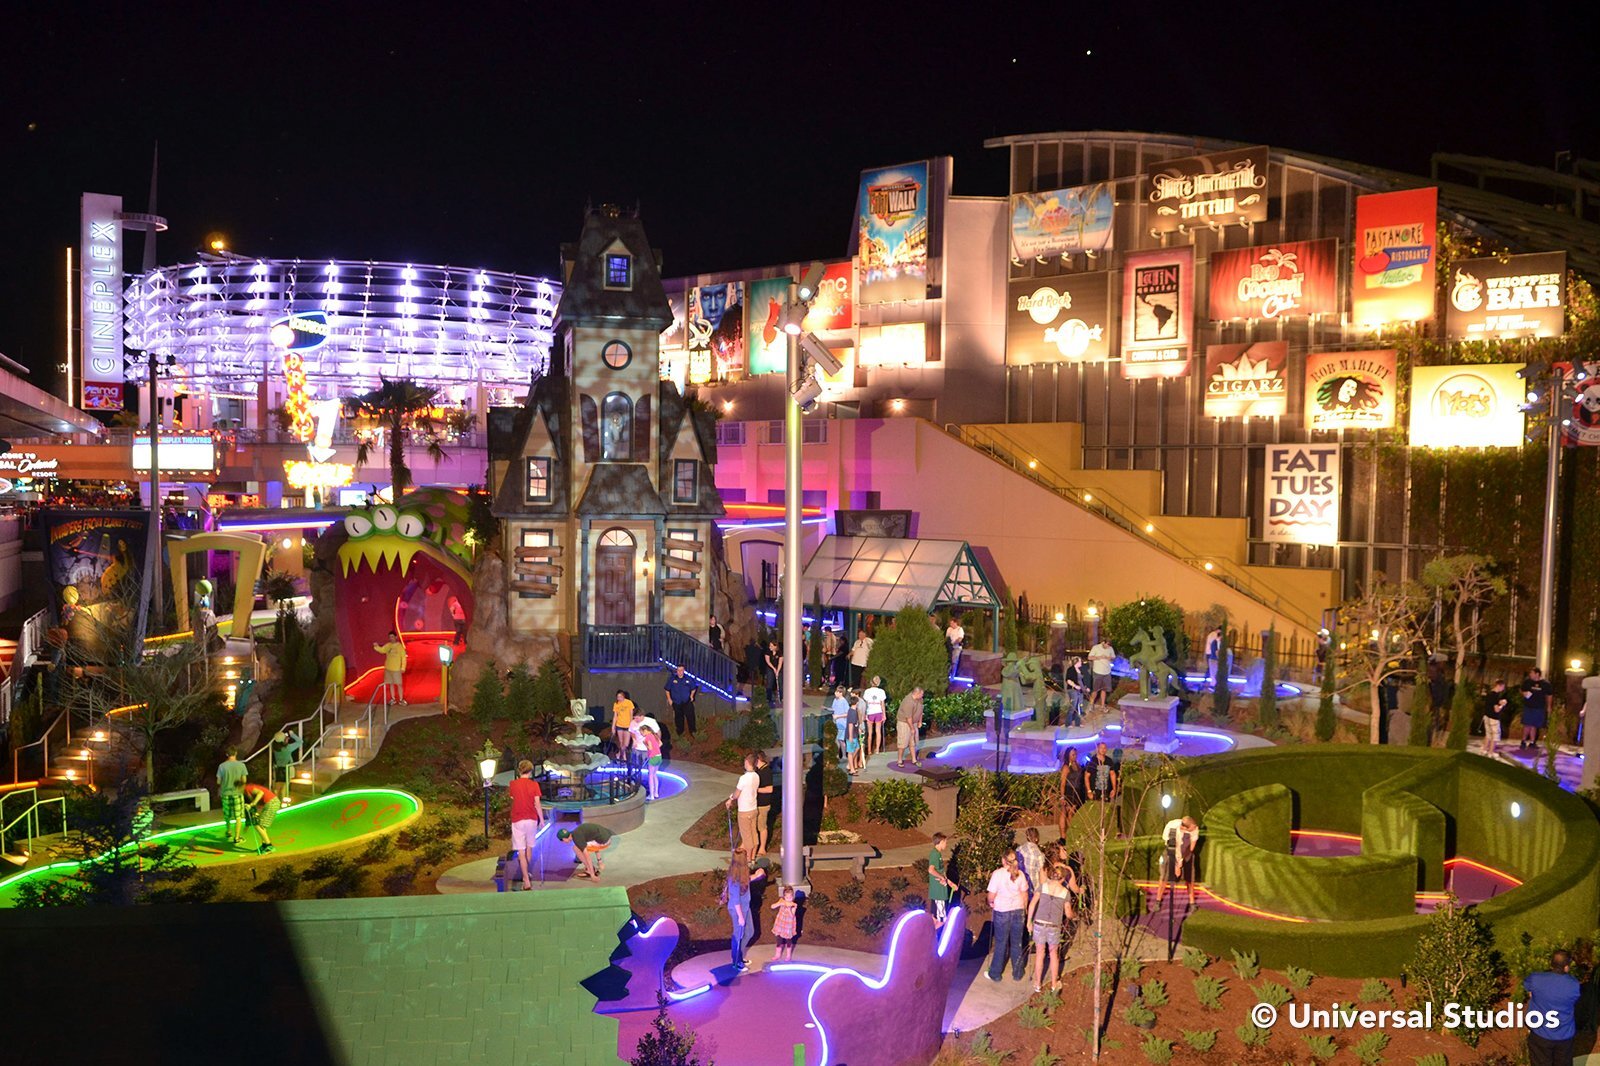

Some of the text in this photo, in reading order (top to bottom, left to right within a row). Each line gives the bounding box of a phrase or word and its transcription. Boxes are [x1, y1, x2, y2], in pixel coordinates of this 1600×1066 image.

[1179, 198, 1235, 218] TATTOO
[818, 276, 848, 292] mc
[1486, 274, 1561, 289] WHOPPER
[92, 222, 116, 374] CINEPLEX
[1018, 291, 1072, 311] Hard Rock
[1486, 285, 1560, 311] BAR
[1311, 360, 1392, 382] BOB MARLEY
[1209, 379, 1284, 393] CIGARZ
[1272, 449, 1336, 473] FAT
[1271, 476, 1334, 496] TUES
[1269, 498, 1332, 518] DAY
[82, 518, 103, 531] FROM
